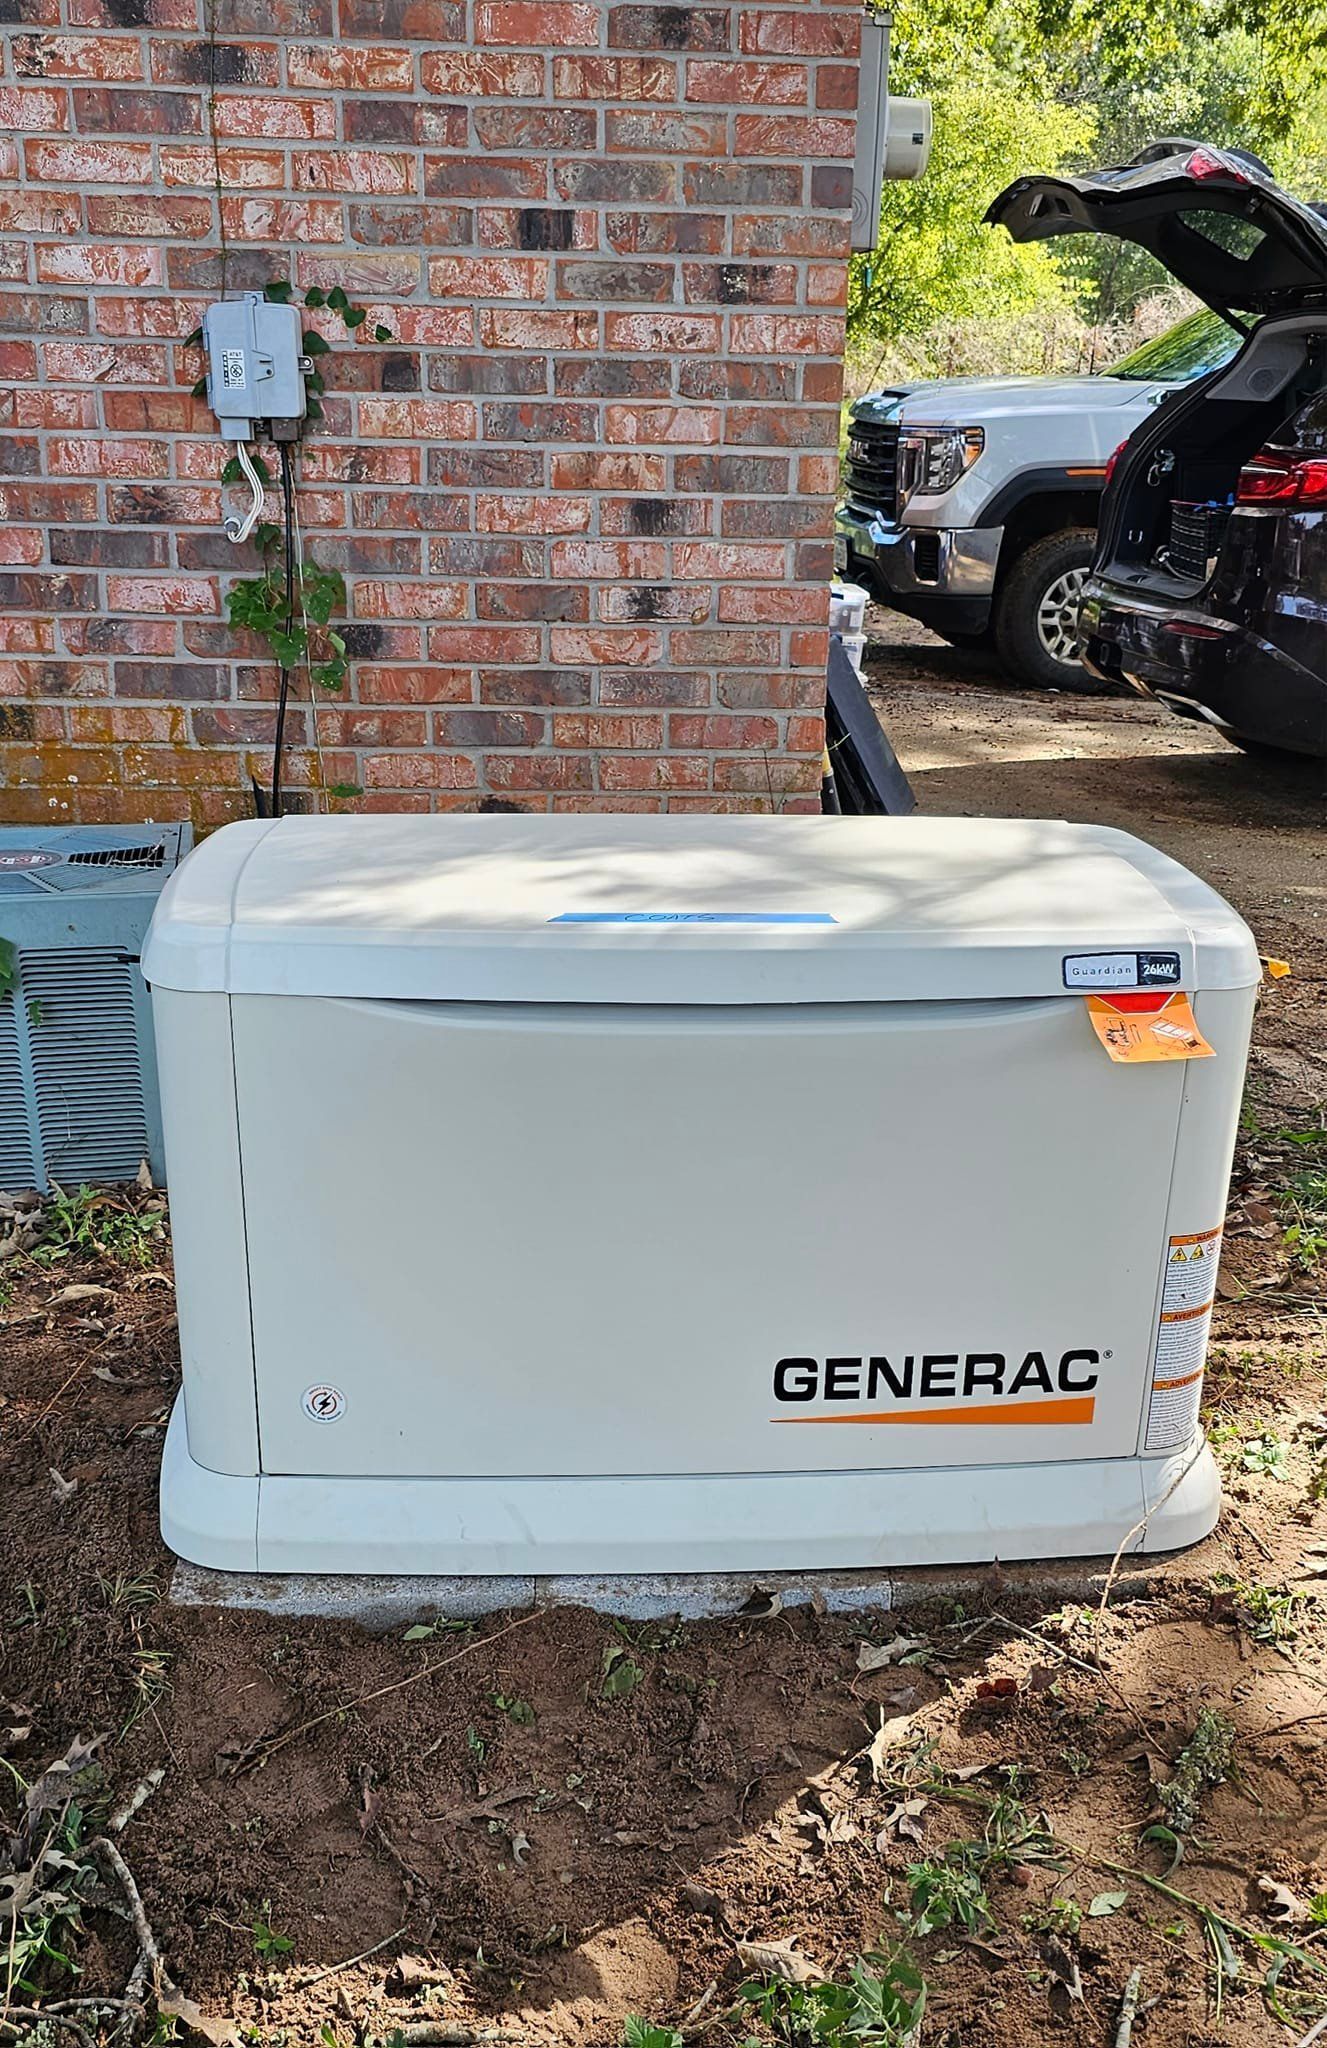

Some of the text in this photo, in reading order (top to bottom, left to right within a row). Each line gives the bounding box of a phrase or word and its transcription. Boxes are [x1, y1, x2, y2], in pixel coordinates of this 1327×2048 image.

[624, 912, 716, 922] COATS
[1072, 966, 1132, 976] Guardian
[1143, 963, 1174, 975] 26kW
